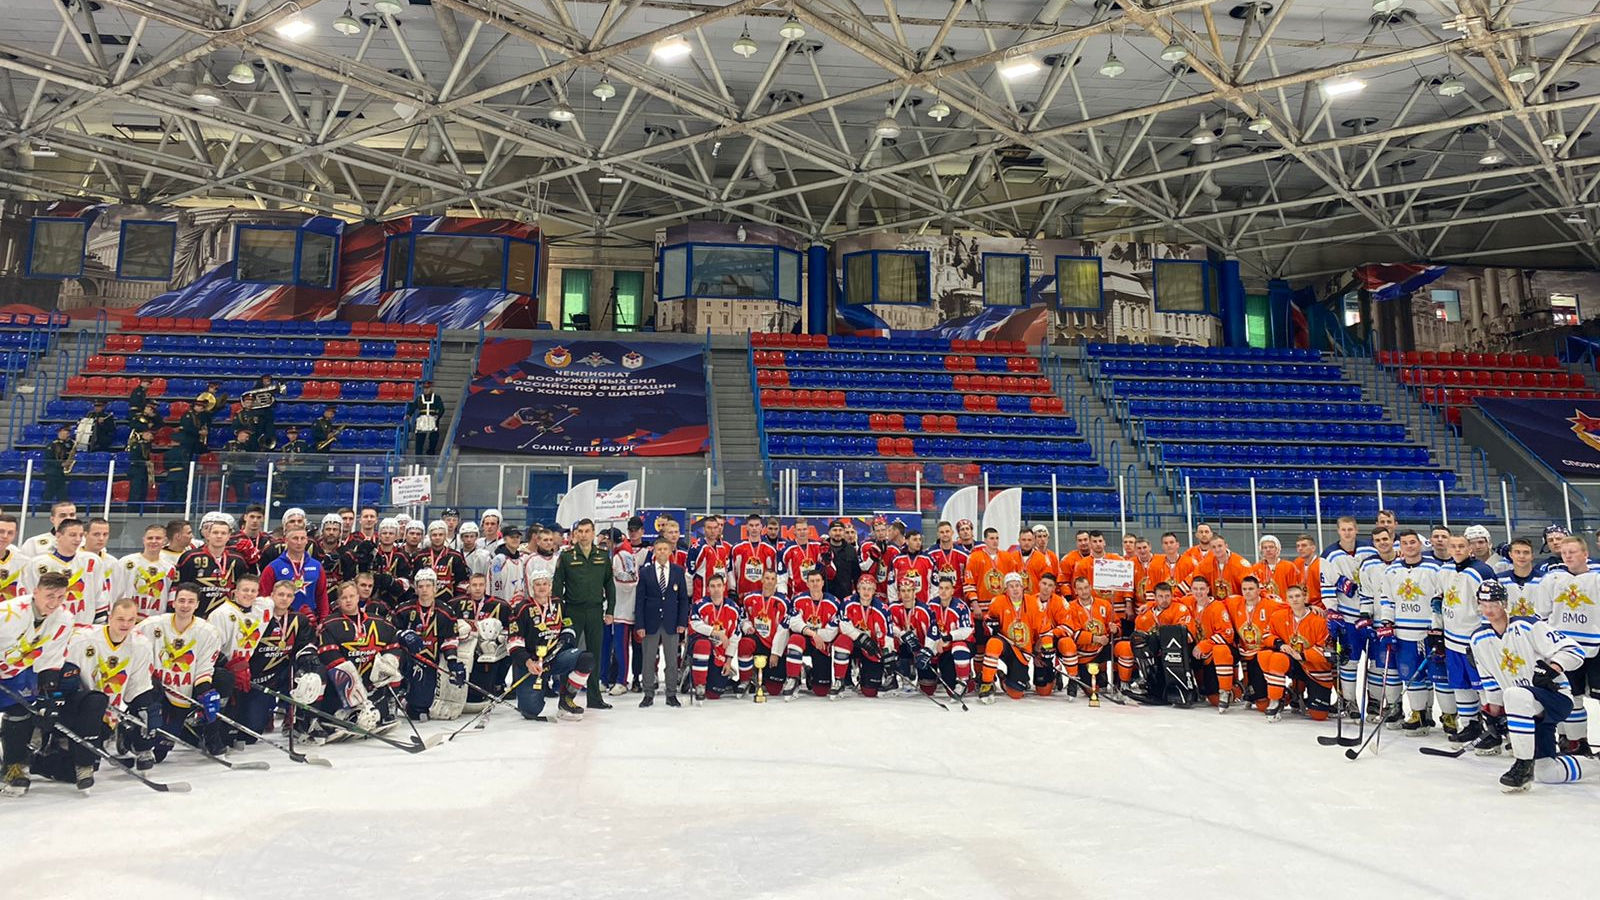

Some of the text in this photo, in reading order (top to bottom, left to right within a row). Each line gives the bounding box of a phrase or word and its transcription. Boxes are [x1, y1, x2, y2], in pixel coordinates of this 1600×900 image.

[555, 370, 630, 378] ЧЕМПИОНАТ
[505, 378, 677, 391] РОССИЙСКОЙ ФЕДЕРАЦИИ
[527, 375, 627, 385] ВООРУЖЕННЫХ
[515, 385, 534, 393] ПО
[537, 388, 593, 397] ХОККЕЮ
[608, 388, 665, 397] ШАЙБОЙ
[532, 443, 635, 452] САНКТ-ПЕТЕРБУРГ
[460, 600, 474, 611] 72
[1401, 603, 1421, 613] ВМФ
[1562, 612, 1588, 625] ВМФ
